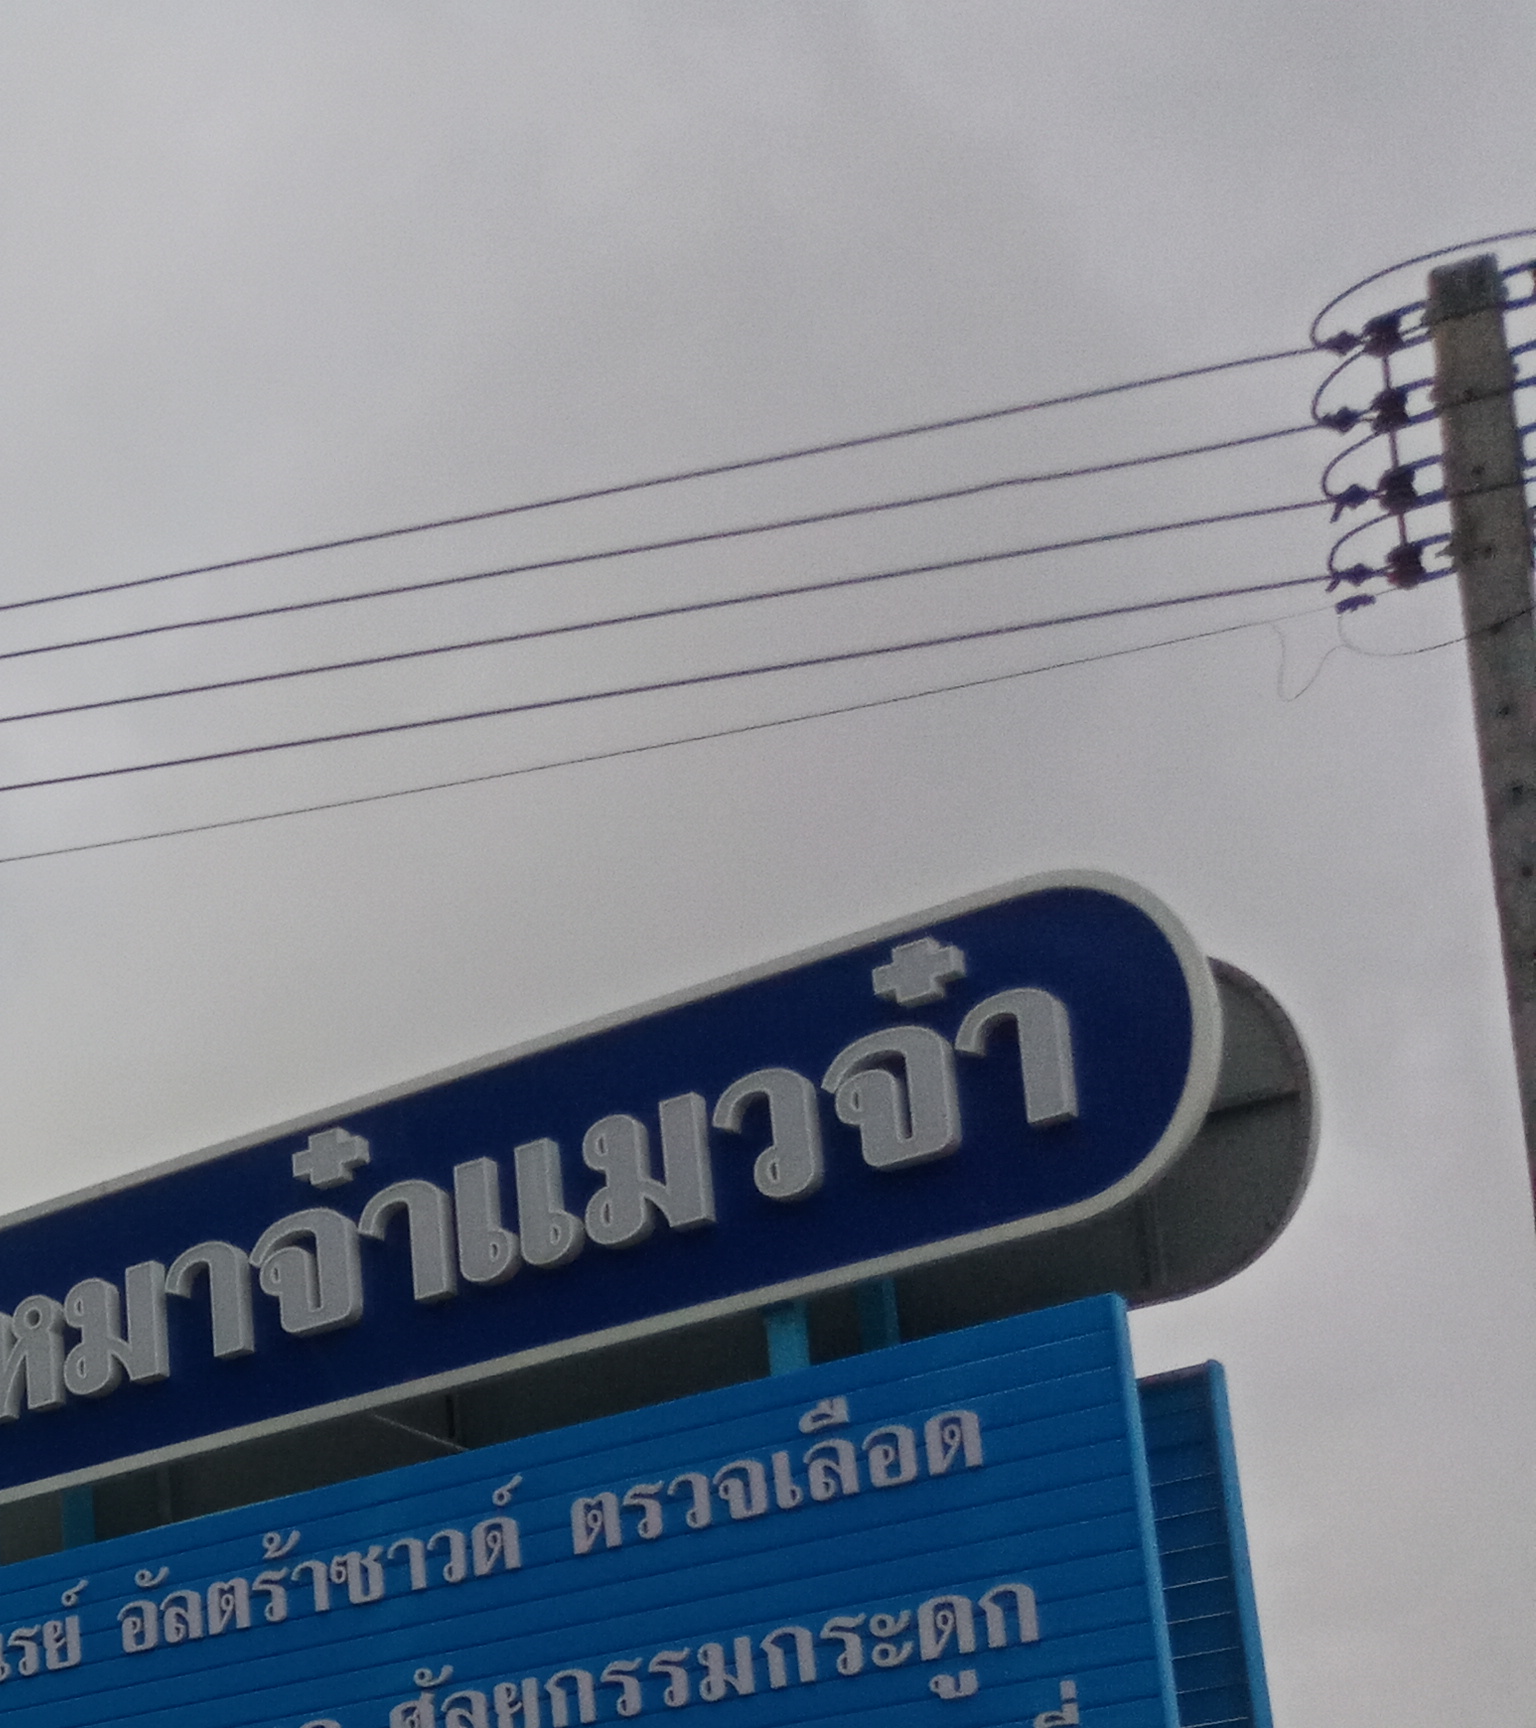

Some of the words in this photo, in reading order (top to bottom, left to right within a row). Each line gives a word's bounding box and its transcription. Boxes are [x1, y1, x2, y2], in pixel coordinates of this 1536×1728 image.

[117, 1474, 525, 1656] อัลตร้าซาวด์
[571, 1395, 985, 1557] ตรวจเลือด
